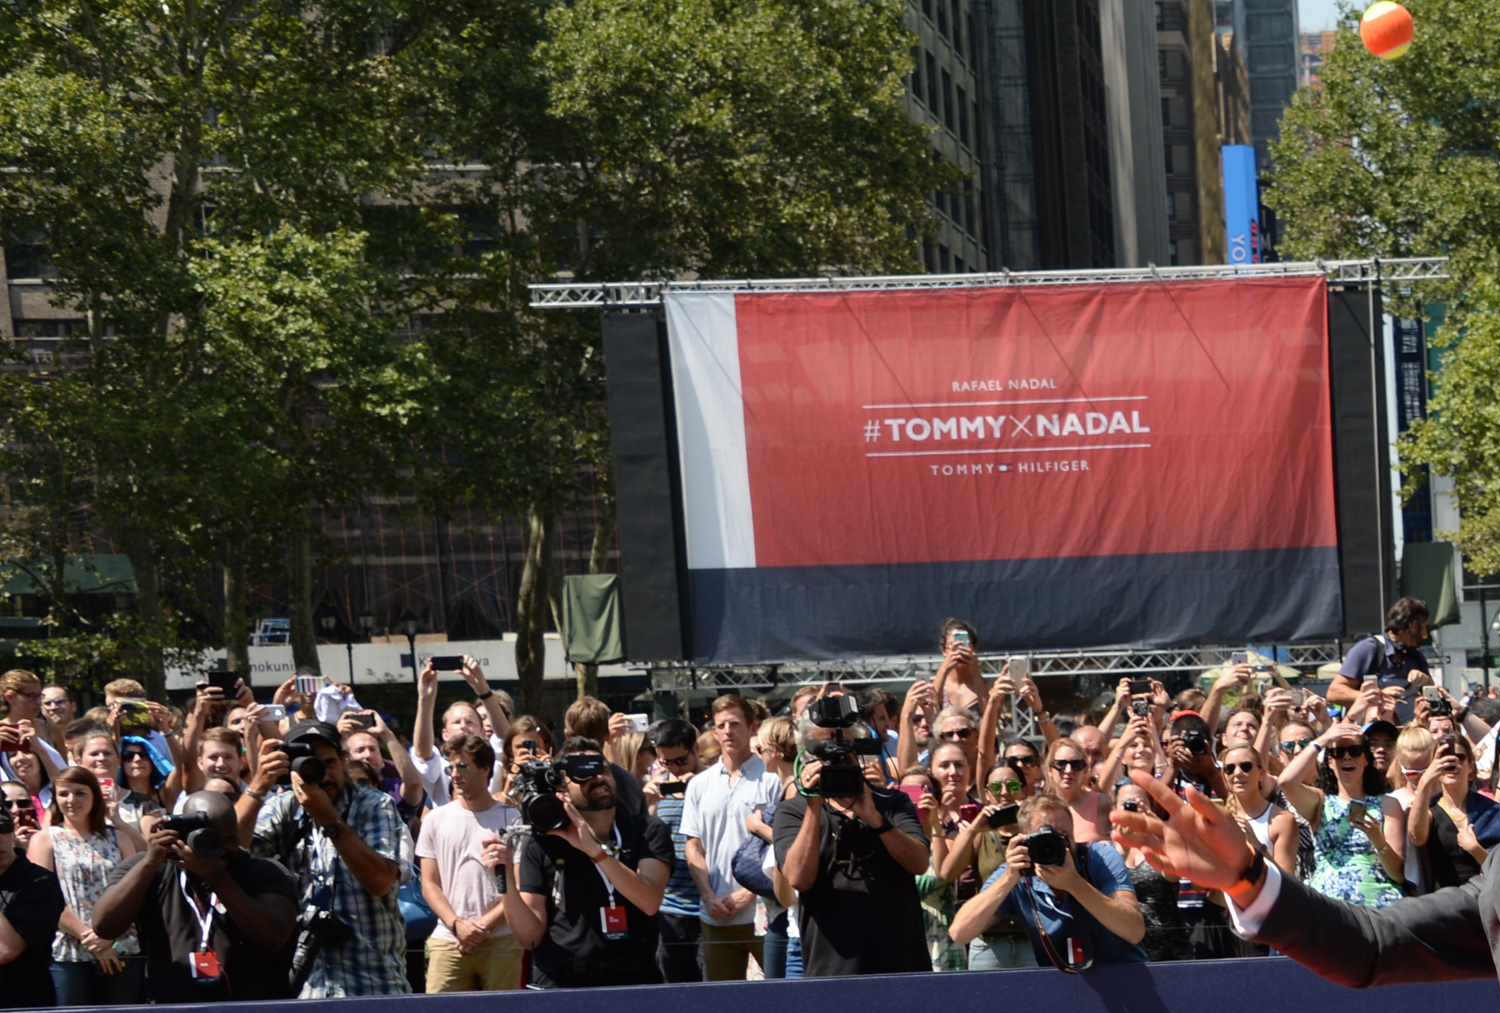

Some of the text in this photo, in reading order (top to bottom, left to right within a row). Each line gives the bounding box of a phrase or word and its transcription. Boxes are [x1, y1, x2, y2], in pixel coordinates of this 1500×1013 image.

[1231, 234, 1246, 265] YO
[952, 378, 1057, 392] RAFAEL NADAL
[930, 460, 1090, 476] TOMMY HILFIGER
